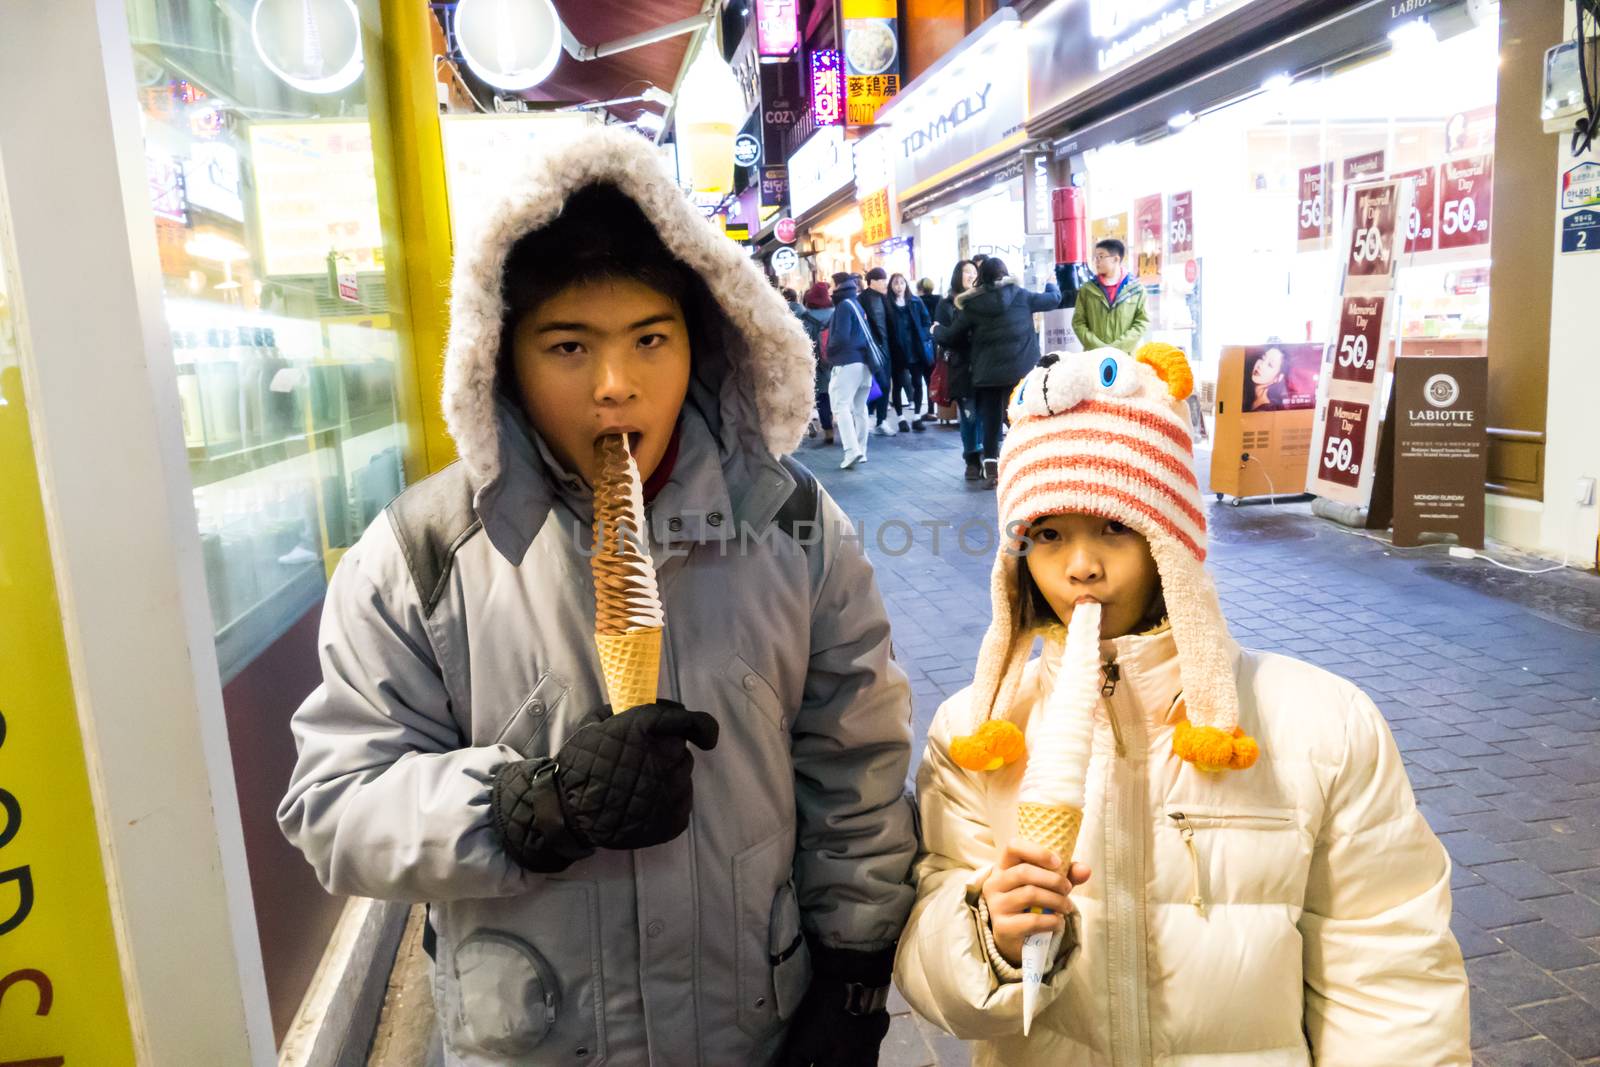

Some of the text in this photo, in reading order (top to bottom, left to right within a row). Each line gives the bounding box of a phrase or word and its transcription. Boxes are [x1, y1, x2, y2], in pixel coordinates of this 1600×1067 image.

[902, 83, 992, 158] TONYMOLY
[1457, 177, 1474, 193] Day
[1577, 231, 1587, 248] 2
[1348, 303, 1378, 316] Memorial
[1356, 315, 1369, 331] Day
[1334, 406, 1362, 422] Memorial
[1408, 410, 1474, 421] LABIOTTE
[1342, 419, 1354, 435] Day
